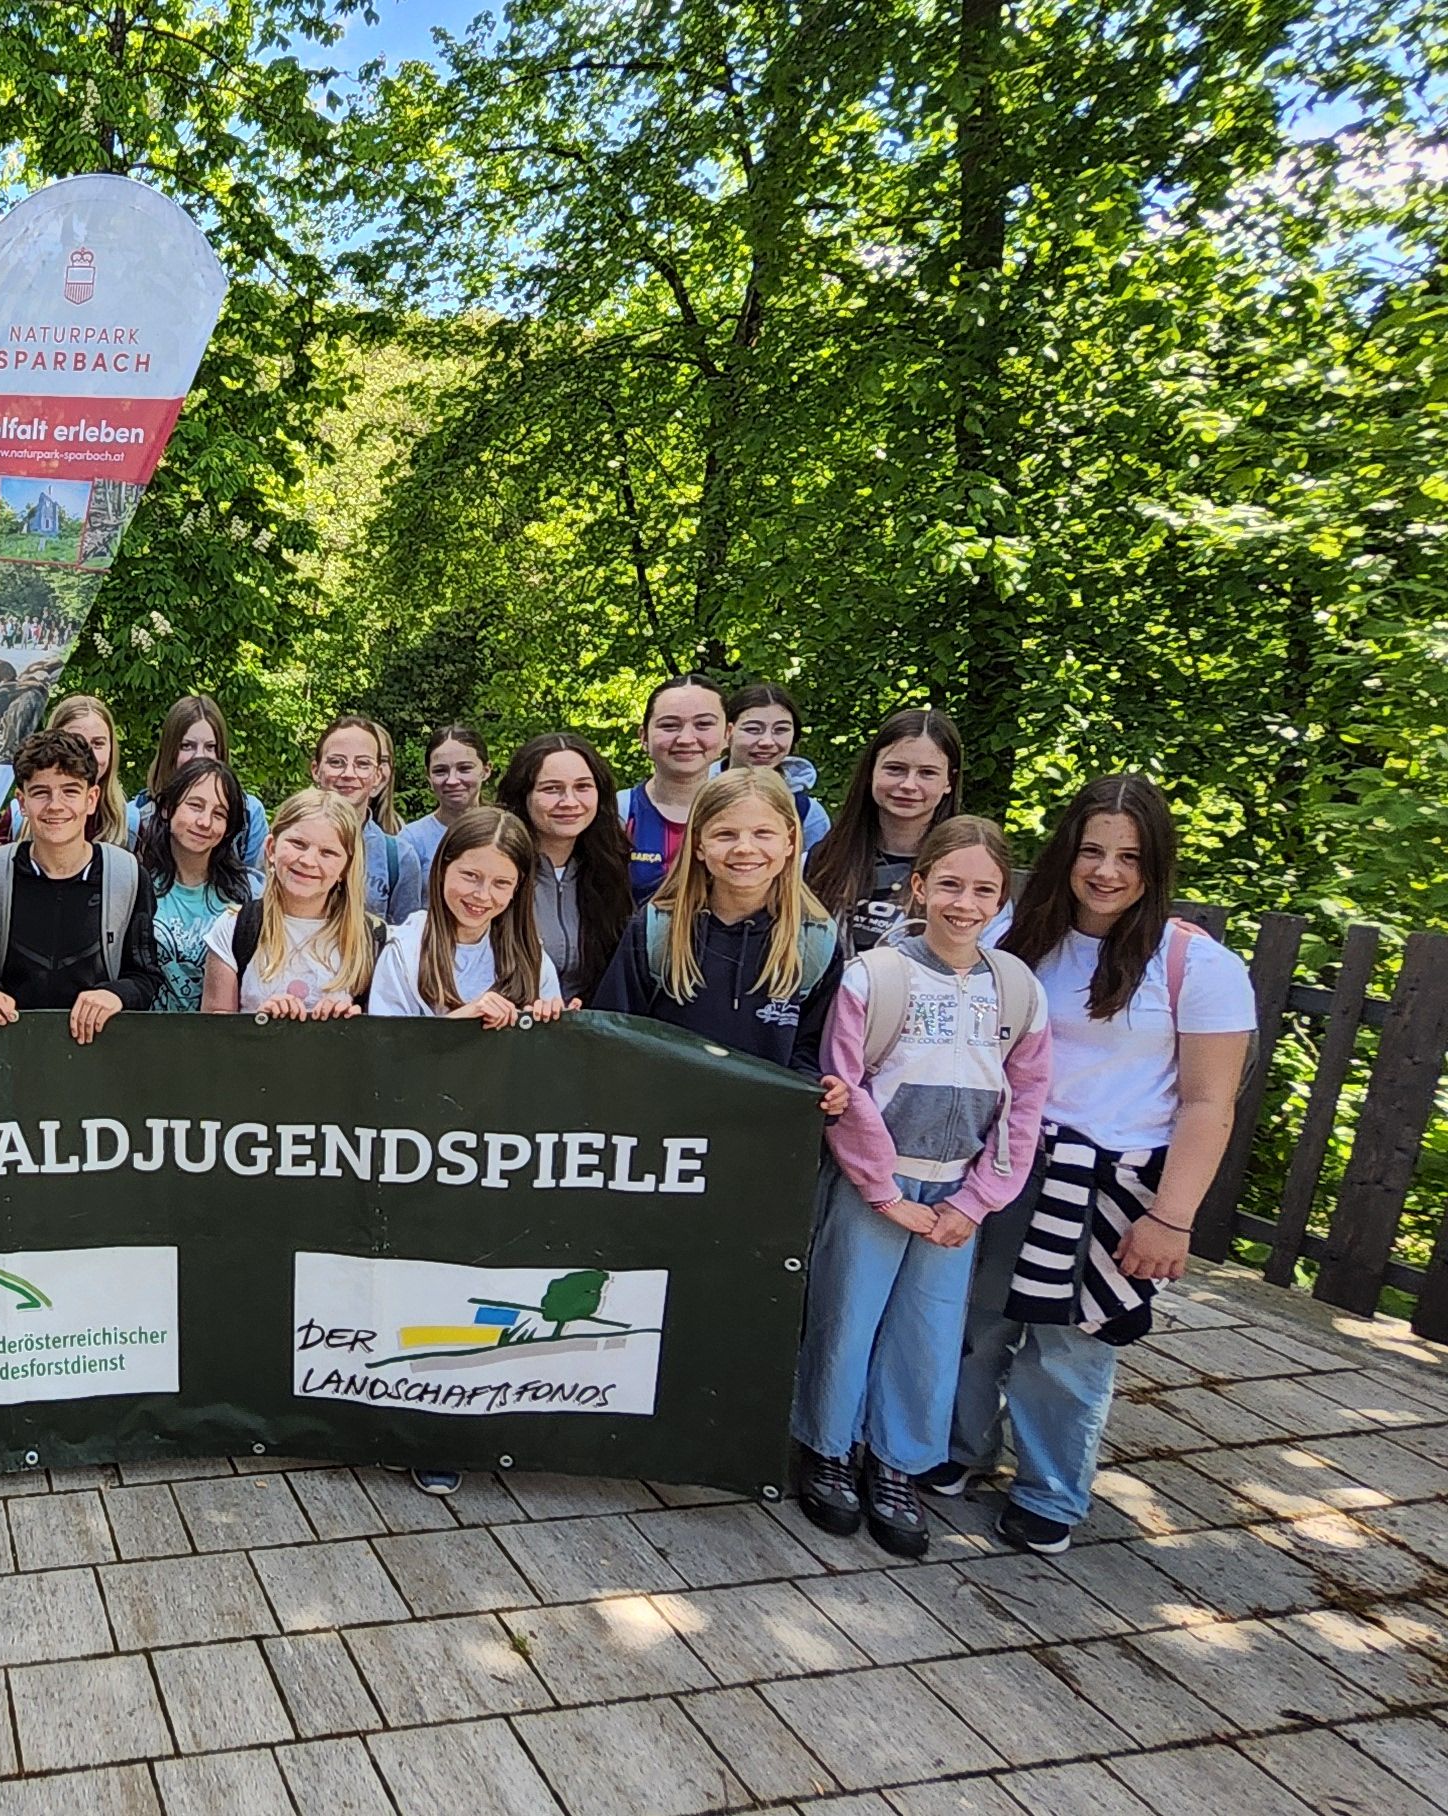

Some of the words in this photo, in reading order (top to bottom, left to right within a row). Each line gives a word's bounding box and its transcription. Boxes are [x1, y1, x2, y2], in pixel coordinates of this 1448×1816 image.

[9, 326, 140, 345] NATURPARK
[53, 419, 145, 444] erleben
[297, 1318, 378, 1353] DER
[301, 1367, 617, 1412] LANDSCHAFTSFONDS
